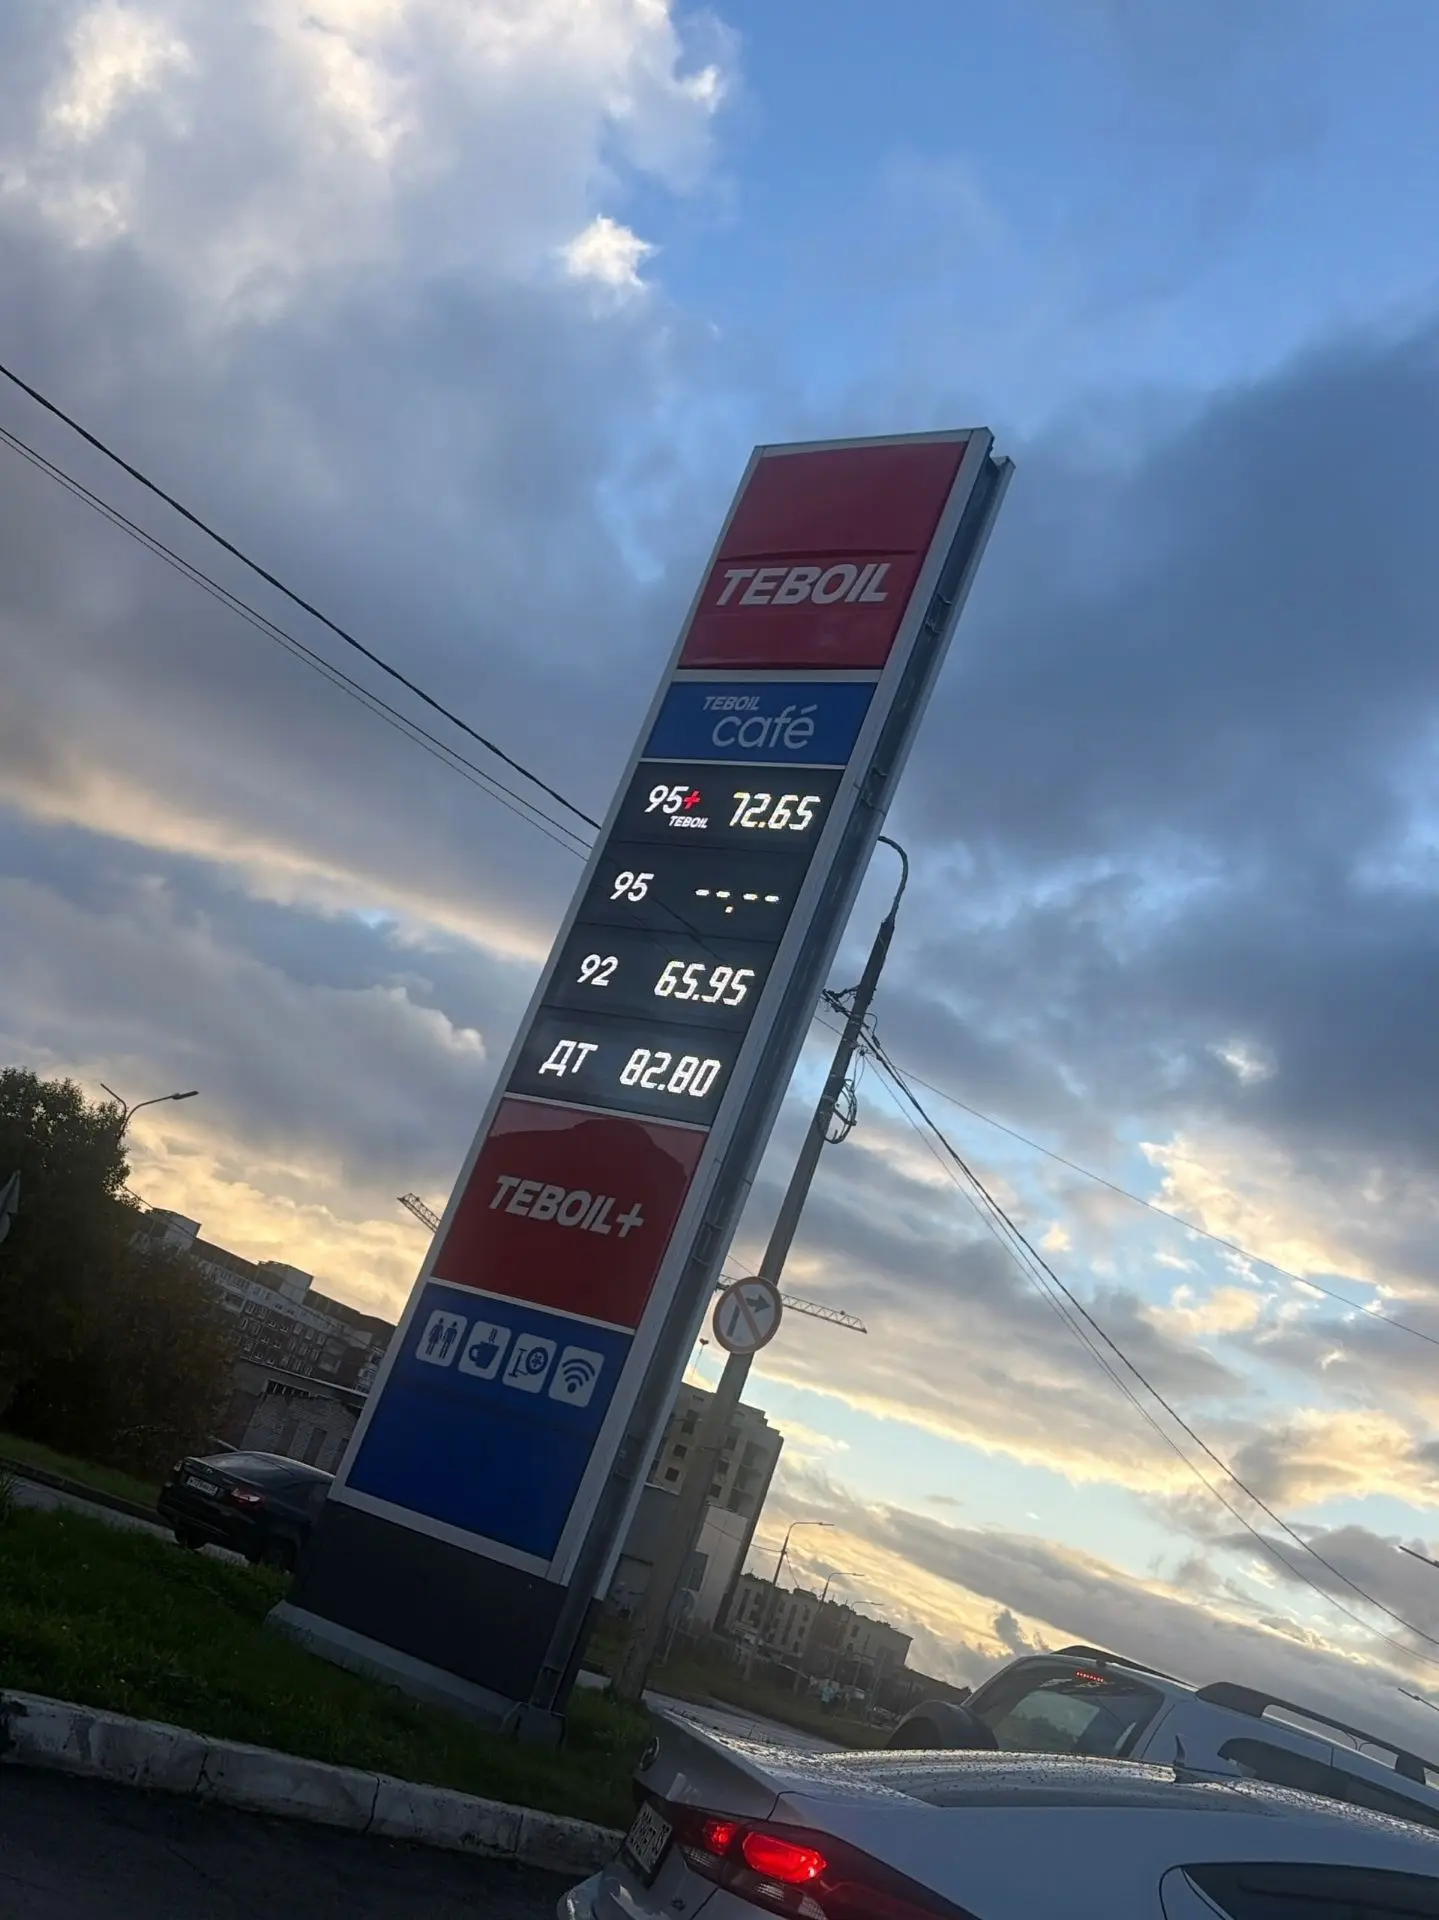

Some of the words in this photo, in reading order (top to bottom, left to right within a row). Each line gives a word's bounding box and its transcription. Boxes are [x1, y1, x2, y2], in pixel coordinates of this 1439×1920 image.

[715, 563, 891, 606] TEBOIL
[702, 696, 761, 711] TEBOIL
[712, 704, 818, 750] café
[668, 815, 709, 829] TEBOIL
[729, 791, 821, 831] 72.65
[610, 871, 655, 902] 95
[576, 953, 619, 987] 92
[653, 960, 756, 1006] 65.95
[538, 1039, 599, 1077] ДТ
[619, 1048, 721, 1098] 82.80
[488, 1174, 645, 1238] TEBOIL+
